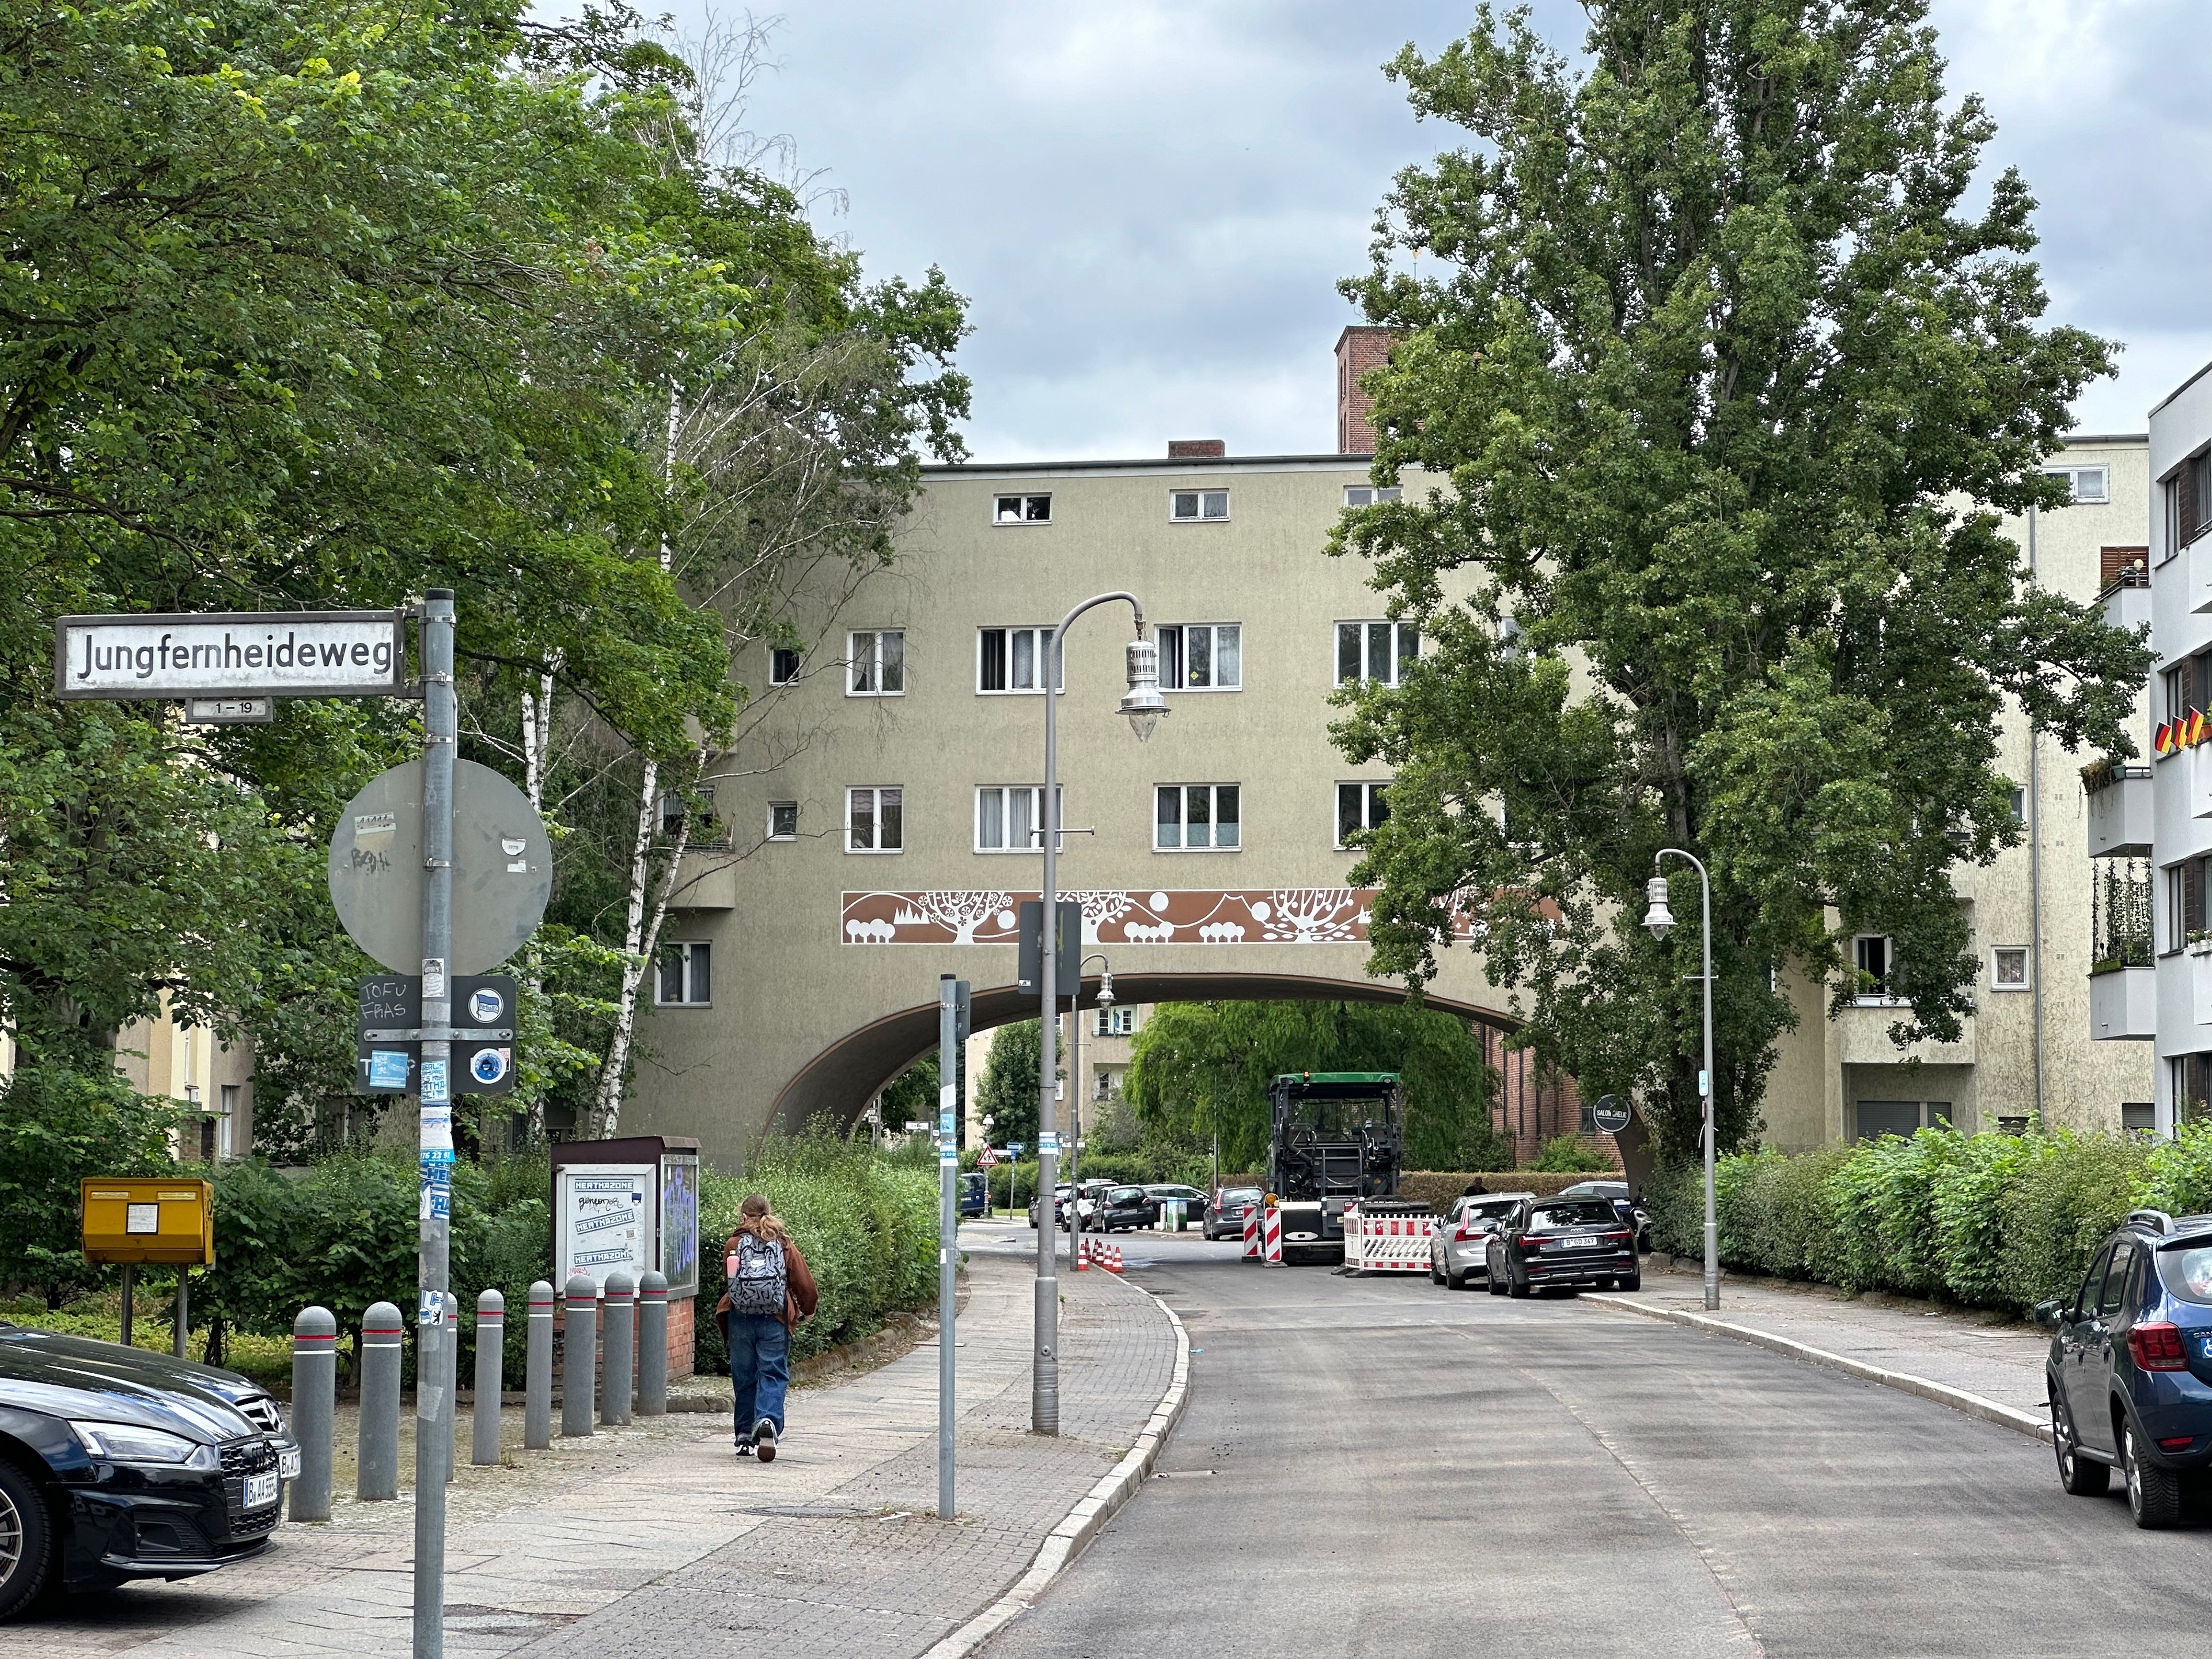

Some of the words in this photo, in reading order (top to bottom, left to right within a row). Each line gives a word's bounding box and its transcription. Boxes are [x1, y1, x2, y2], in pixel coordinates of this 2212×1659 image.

[78, 632, 392, 679] Jungfernheideweg
[216, 702, 221, 714] 1
[239, 702, 252, 714] 19
[361, 982, 407, 1000] TOFU
[360, 1002, 406, 1019] FRAS
[575, 1181, 633, 1190] HERTHAZONE
[577, 1213, 634, 1232] HERTHAZONE
[282, 1456, 287, 1475] B
[249, 1482, 253, 1503] B
